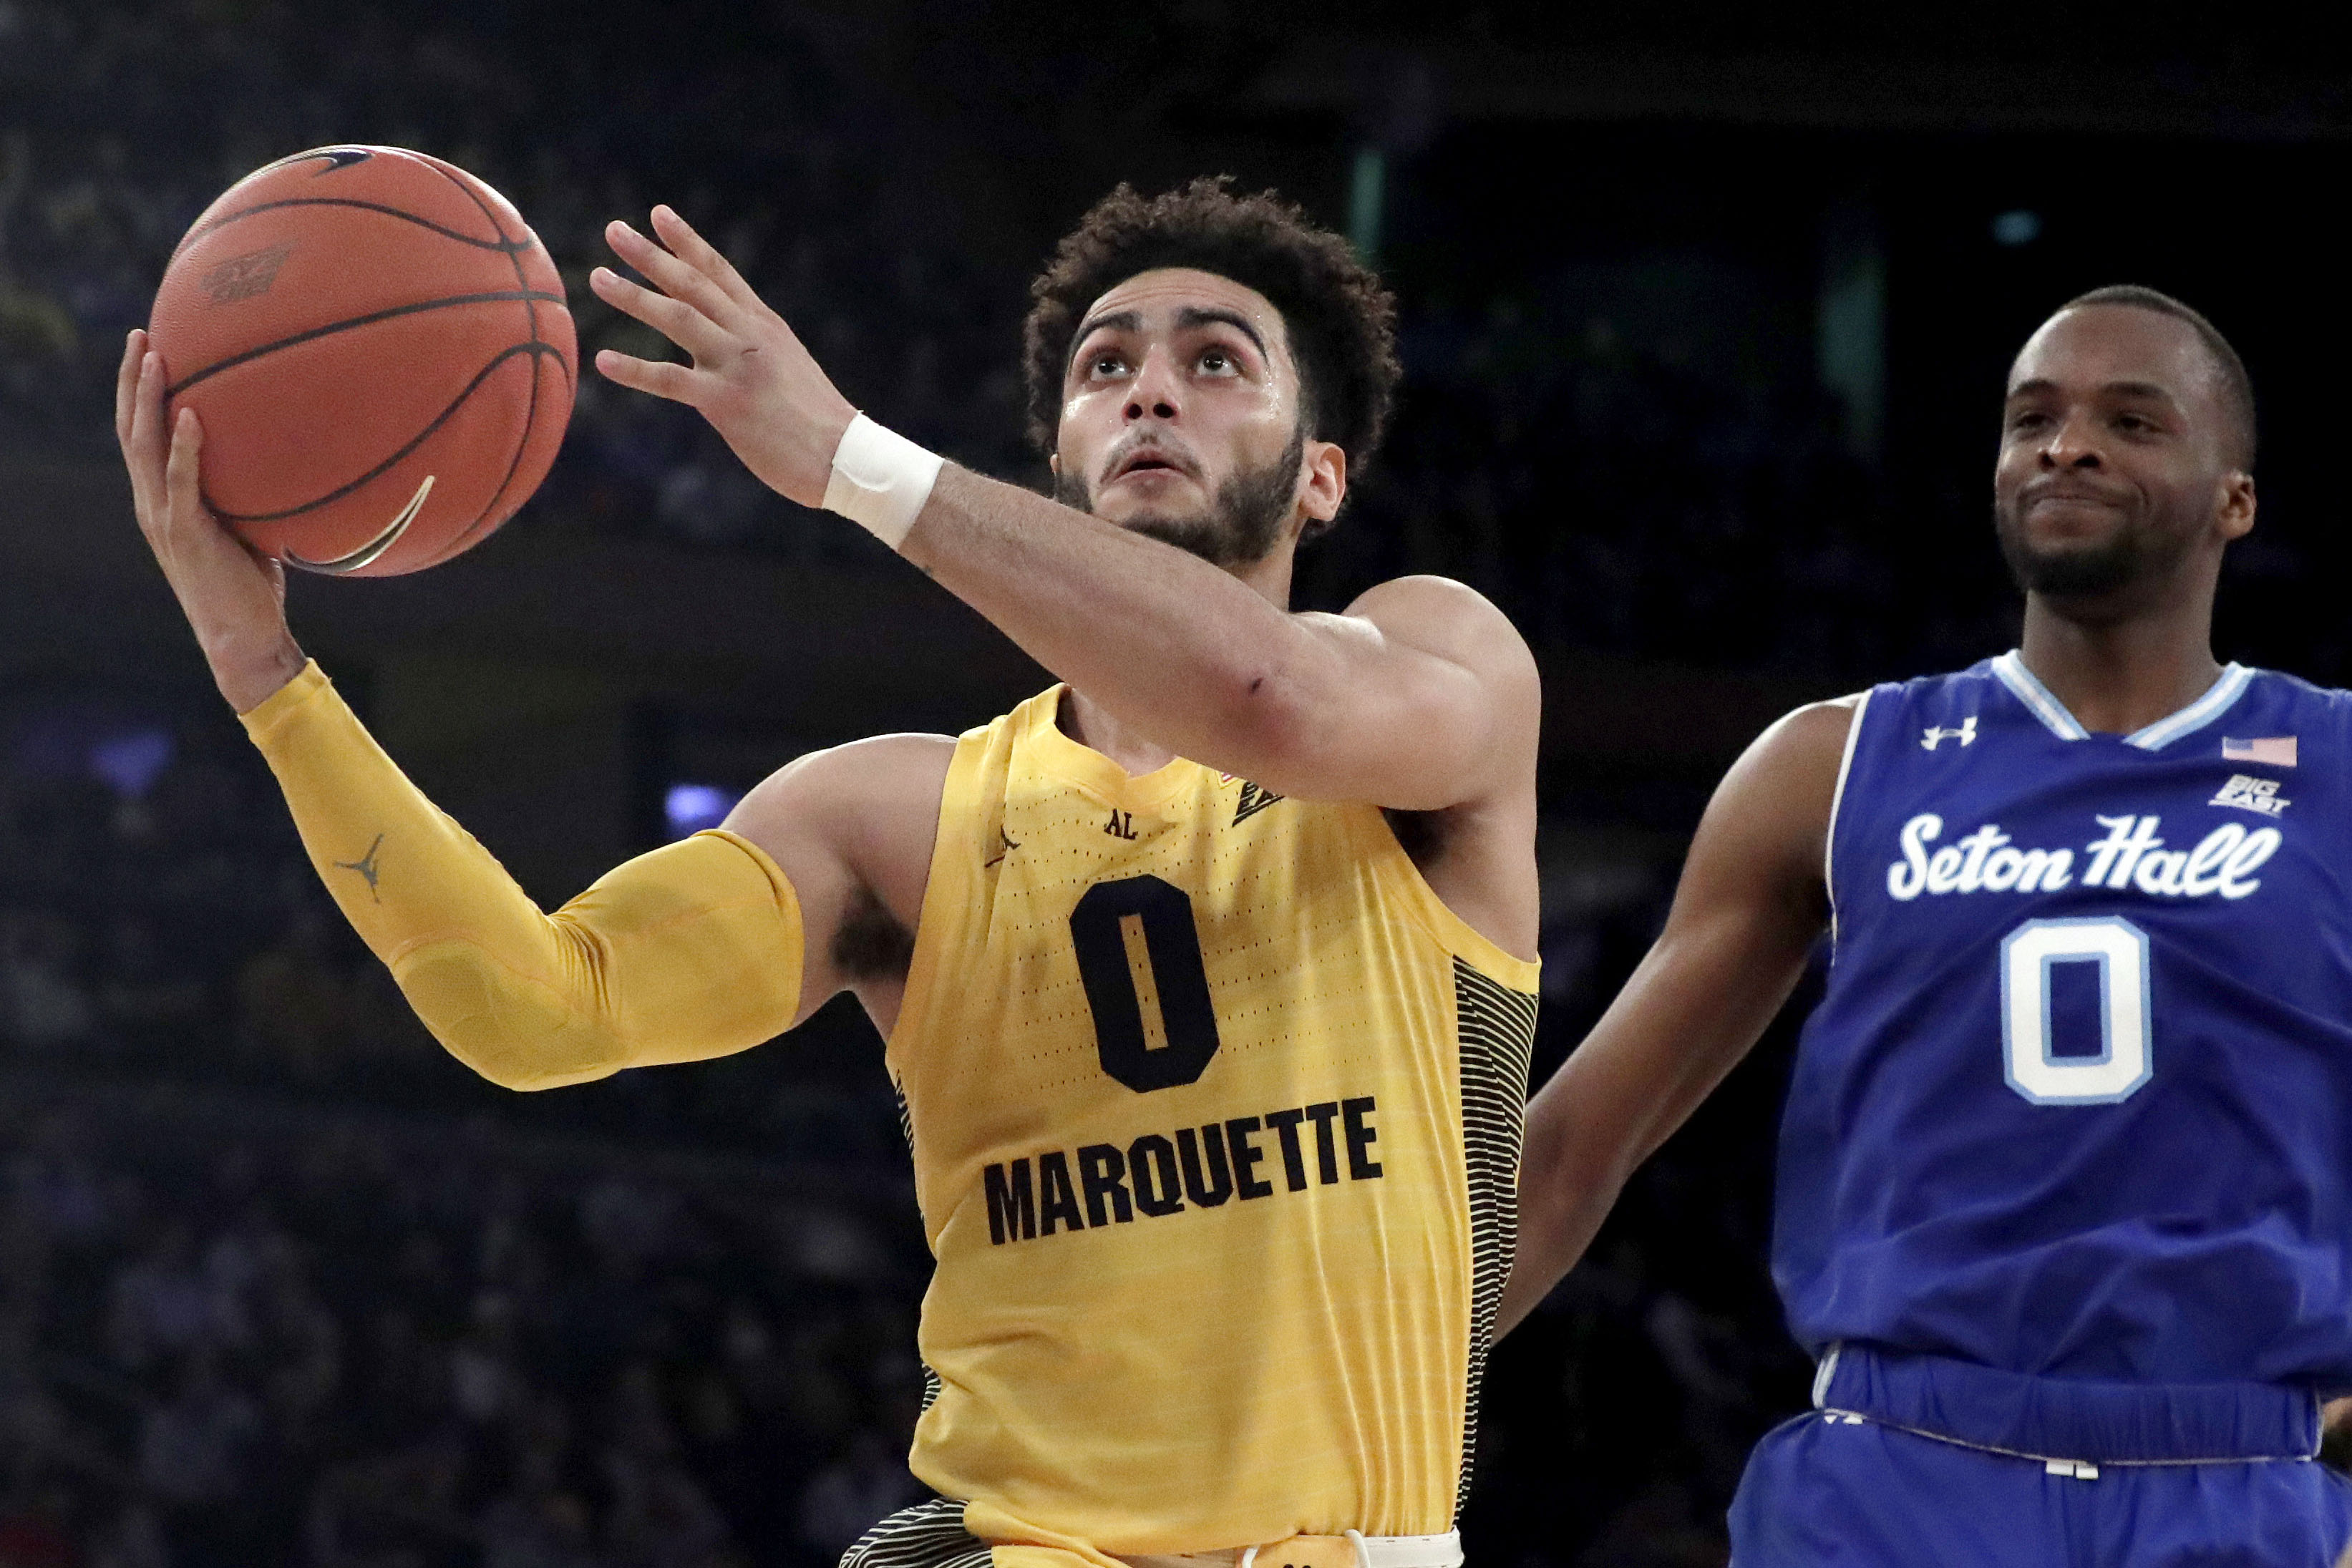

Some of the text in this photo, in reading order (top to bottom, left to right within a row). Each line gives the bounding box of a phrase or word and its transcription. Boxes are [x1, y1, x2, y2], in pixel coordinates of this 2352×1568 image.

[1104, 808, 1139, 840] AL
[2215, 789, 2291, 813] EAST
[2225, 774, 2281, 797] BIG
[1887, 813, 2283, 901] Seton Hall
[1069, 874, 1220, 1094] 0
[2000, 915, 2153, 1106] 0
[984, 1096, 1383, 1246] MARQUETTE
